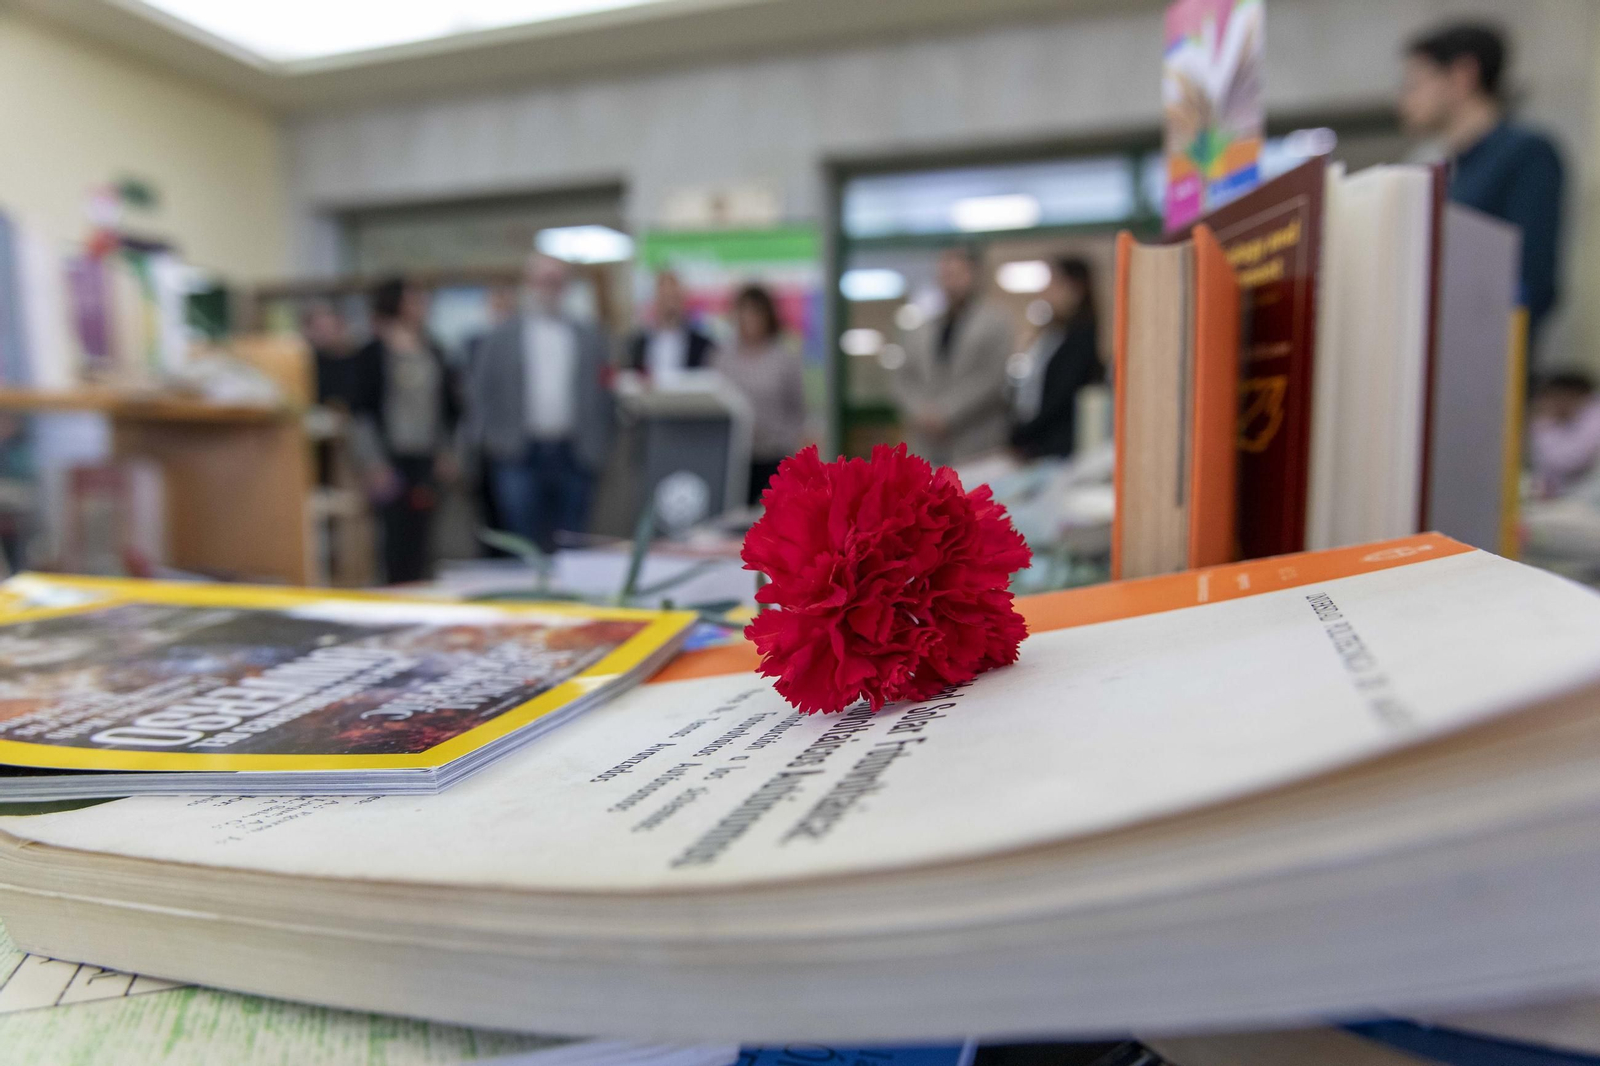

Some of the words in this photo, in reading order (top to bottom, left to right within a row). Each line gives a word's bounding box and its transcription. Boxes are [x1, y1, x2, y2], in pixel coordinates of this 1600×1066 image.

[692, 711, 778, 758] Fotovoltaicos
[886, 702, 957, 735] Solar
[589, 742, 677, 784] Avanzados
[703, 766, 746, 781] los
